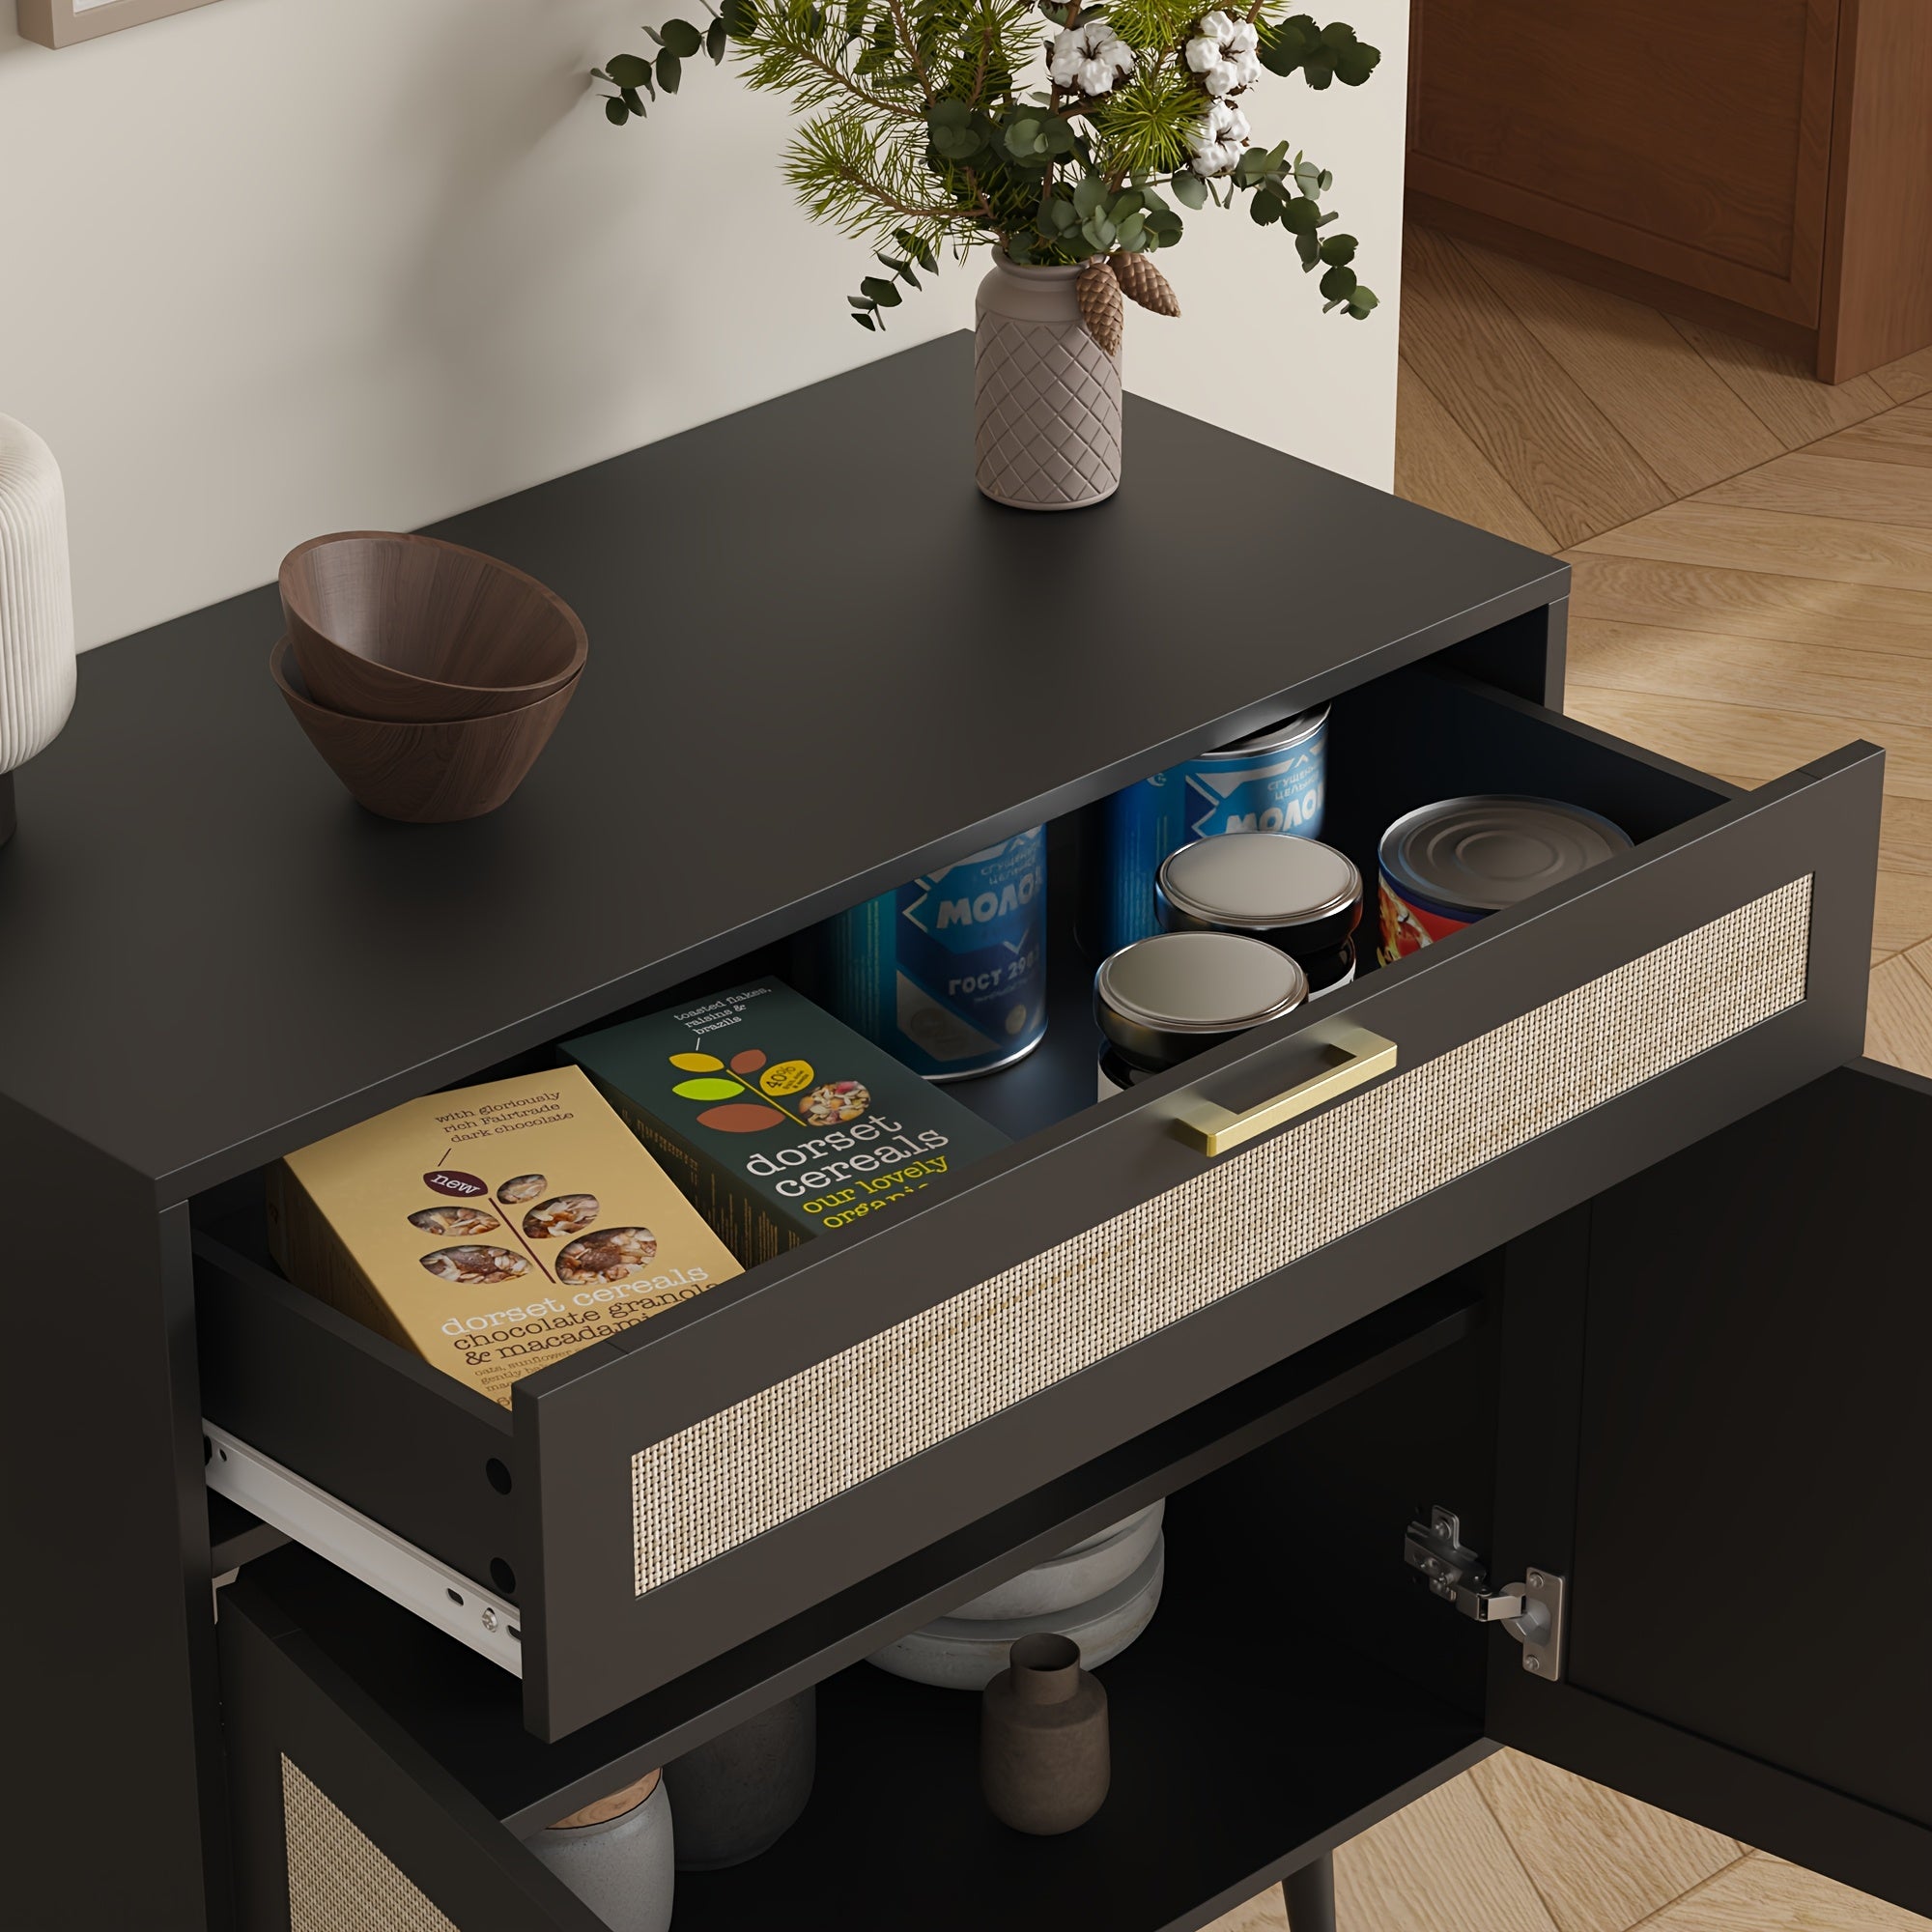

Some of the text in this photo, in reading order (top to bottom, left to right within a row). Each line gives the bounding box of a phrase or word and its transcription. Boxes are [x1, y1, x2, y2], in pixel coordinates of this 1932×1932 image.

[1226, 783, 1323, 834] МОЛО
[937, 866, 1042, 928] МОЛО
[949, 968, 1003, 996] ГОСТ
[673, 1000, 726, 1021] toasted
[684, 1004, 747, 1028] raisins &
[693, 1015, 743, 1035] brazils
[766, 1065, 797, 1089] 40%
[435, 1092, 560, 1123] with gloriously
[443, 1103, 560, 1134] rich Fairtrade
[450, 1112, 575, 1143] dark chocolate
[746, 1115, 902, 1177] dorset
[775, 1129, 950, 1197] cereals
[430, 1174, 481, 1195] new
[803, 1155, 950, 1214] our lovely
[823, 1181, 929, 1230] organ
[440, 1266, 710, 1337] dorset cereals
[453, 1307, 601, 1351] chocolate
[465, 1312, 651, 1366] & macadam
[474, 1364, 507, 1377] oats,
